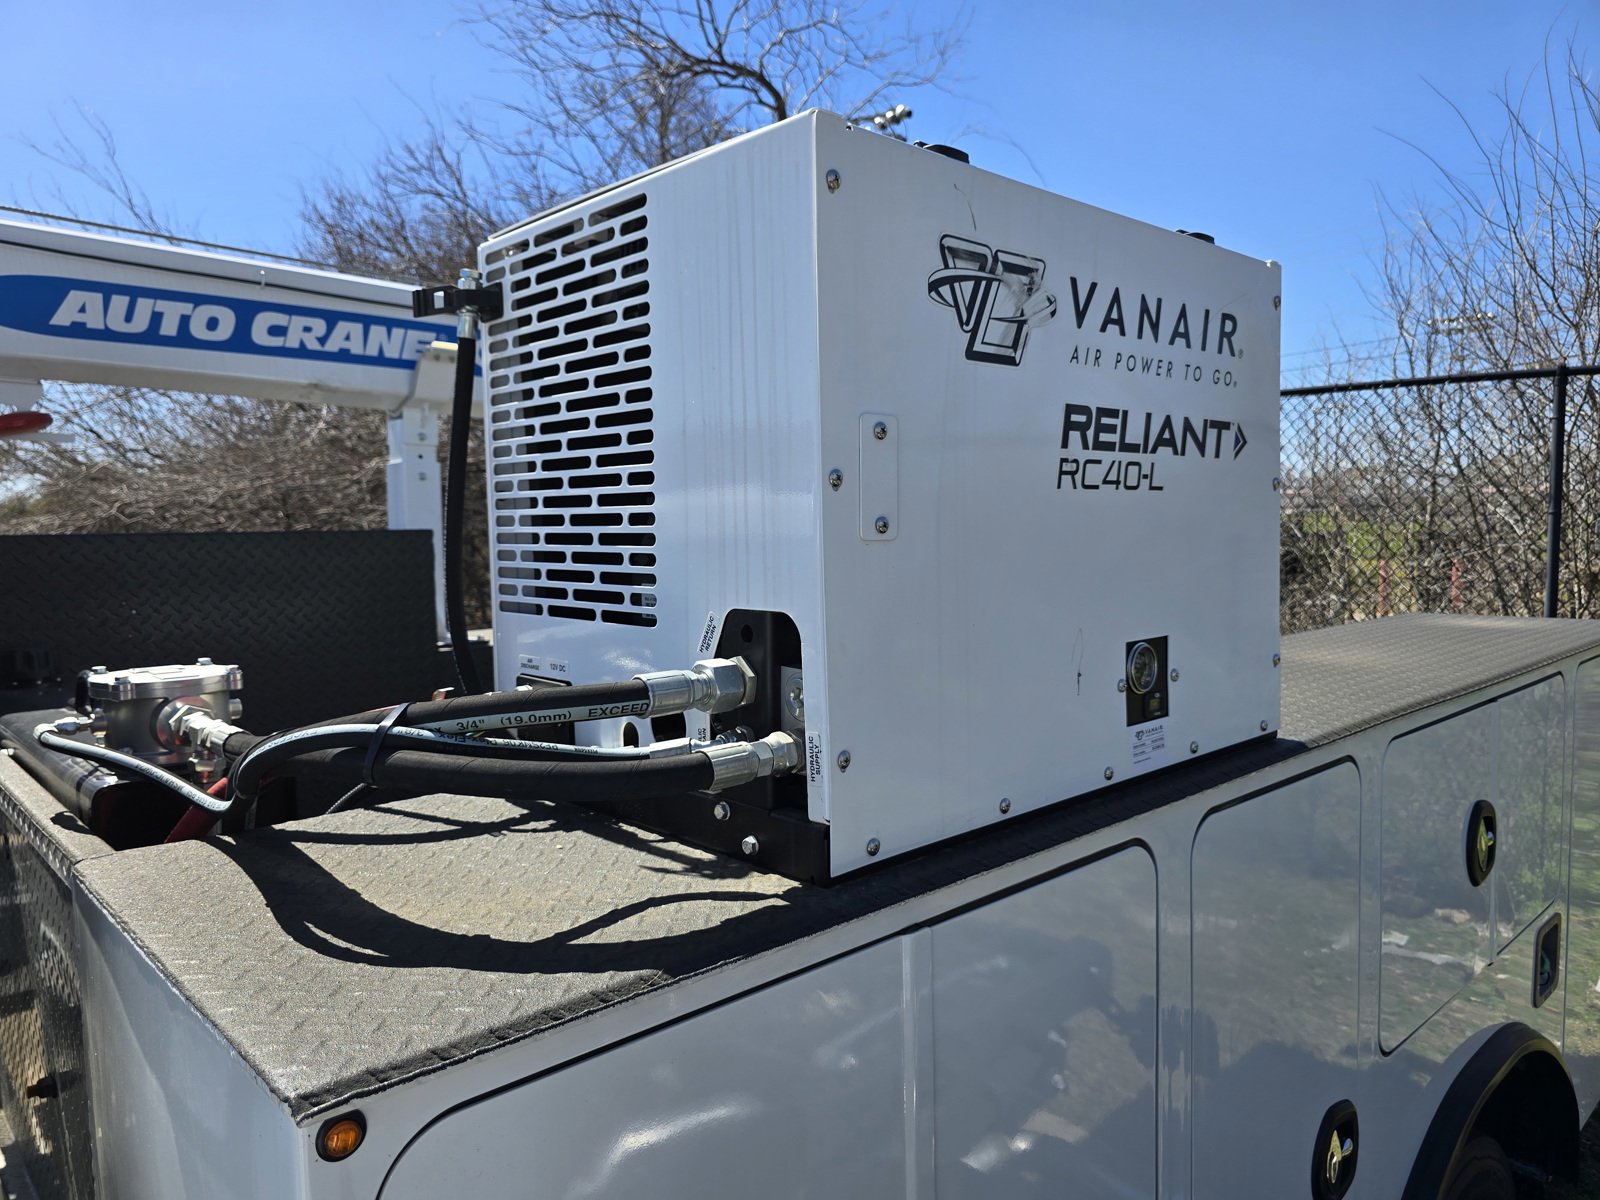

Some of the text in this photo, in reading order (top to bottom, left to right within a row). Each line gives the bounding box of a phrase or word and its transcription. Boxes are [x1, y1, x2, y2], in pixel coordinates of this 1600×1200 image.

[48, 289, 437, 362] AUTO CRANE
[1069, 275, 1237, 358] VANAIR
[1069, 344, 1102, 368] AIR
[1114, 352, 1174, 379] POWER
[1184, 363, 1203, 383] TO
[1060, 402, 1232, 460] RELIANT
[1056, 457, 1165, 492] RC40-L
[456, 719, 485, 732] 3/4"
[500, 710, 572, 726] (19.0mm)
[808, 736, 816, 783] HYDRAULIC
